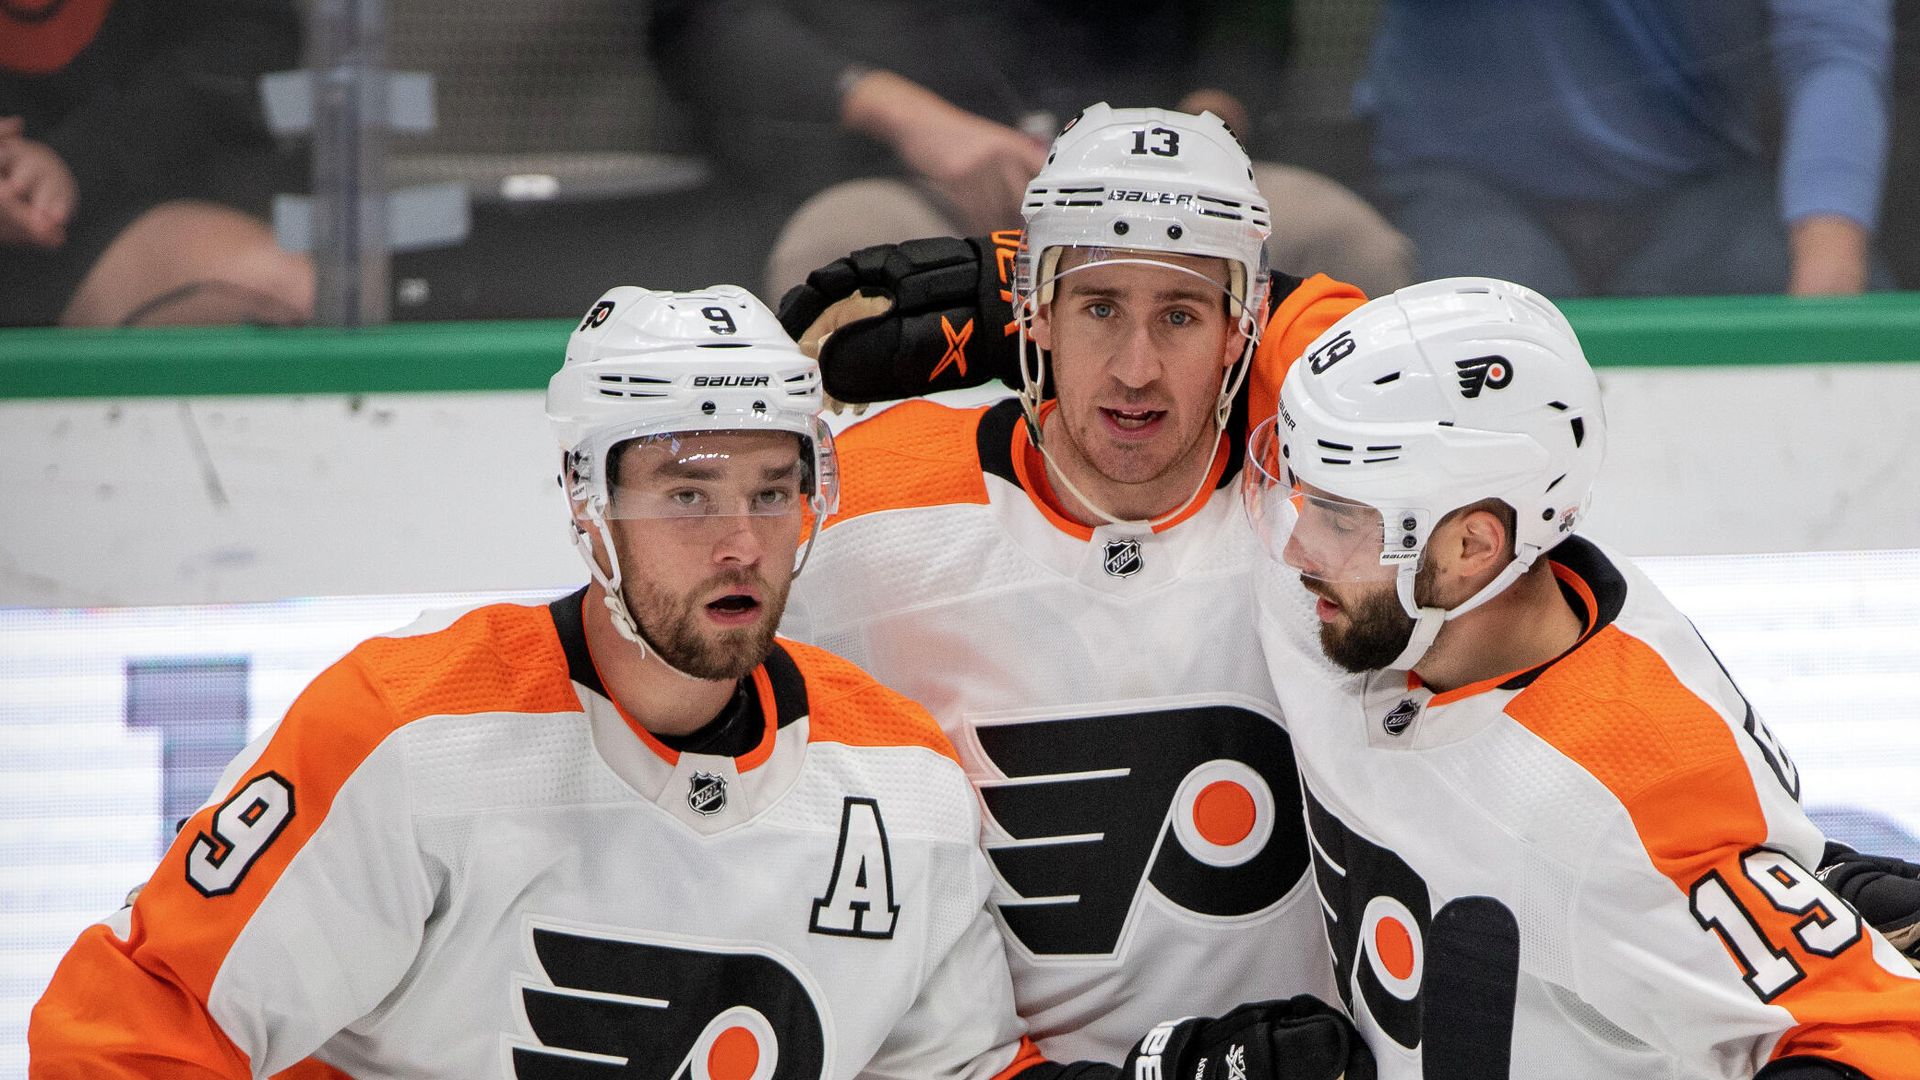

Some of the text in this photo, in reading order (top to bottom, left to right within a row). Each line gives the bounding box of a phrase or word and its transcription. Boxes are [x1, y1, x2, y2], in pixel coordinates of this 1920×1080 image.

[1130, 127, 1180, 157] 13
[701, 306, 737, 335] 9
[1307, 330, 1356, 375] 19
[693, 375, 770, 387] BAUER
[1279, 393, 1297, 431] AUER
[1112, 548, 1135, 571] NHL
[695, 785, 720, 806] NHL
[185, 770, 296, 898] 9
[809, 796, 900, 940] A
[1689, 845, 1864, 1005] 19
